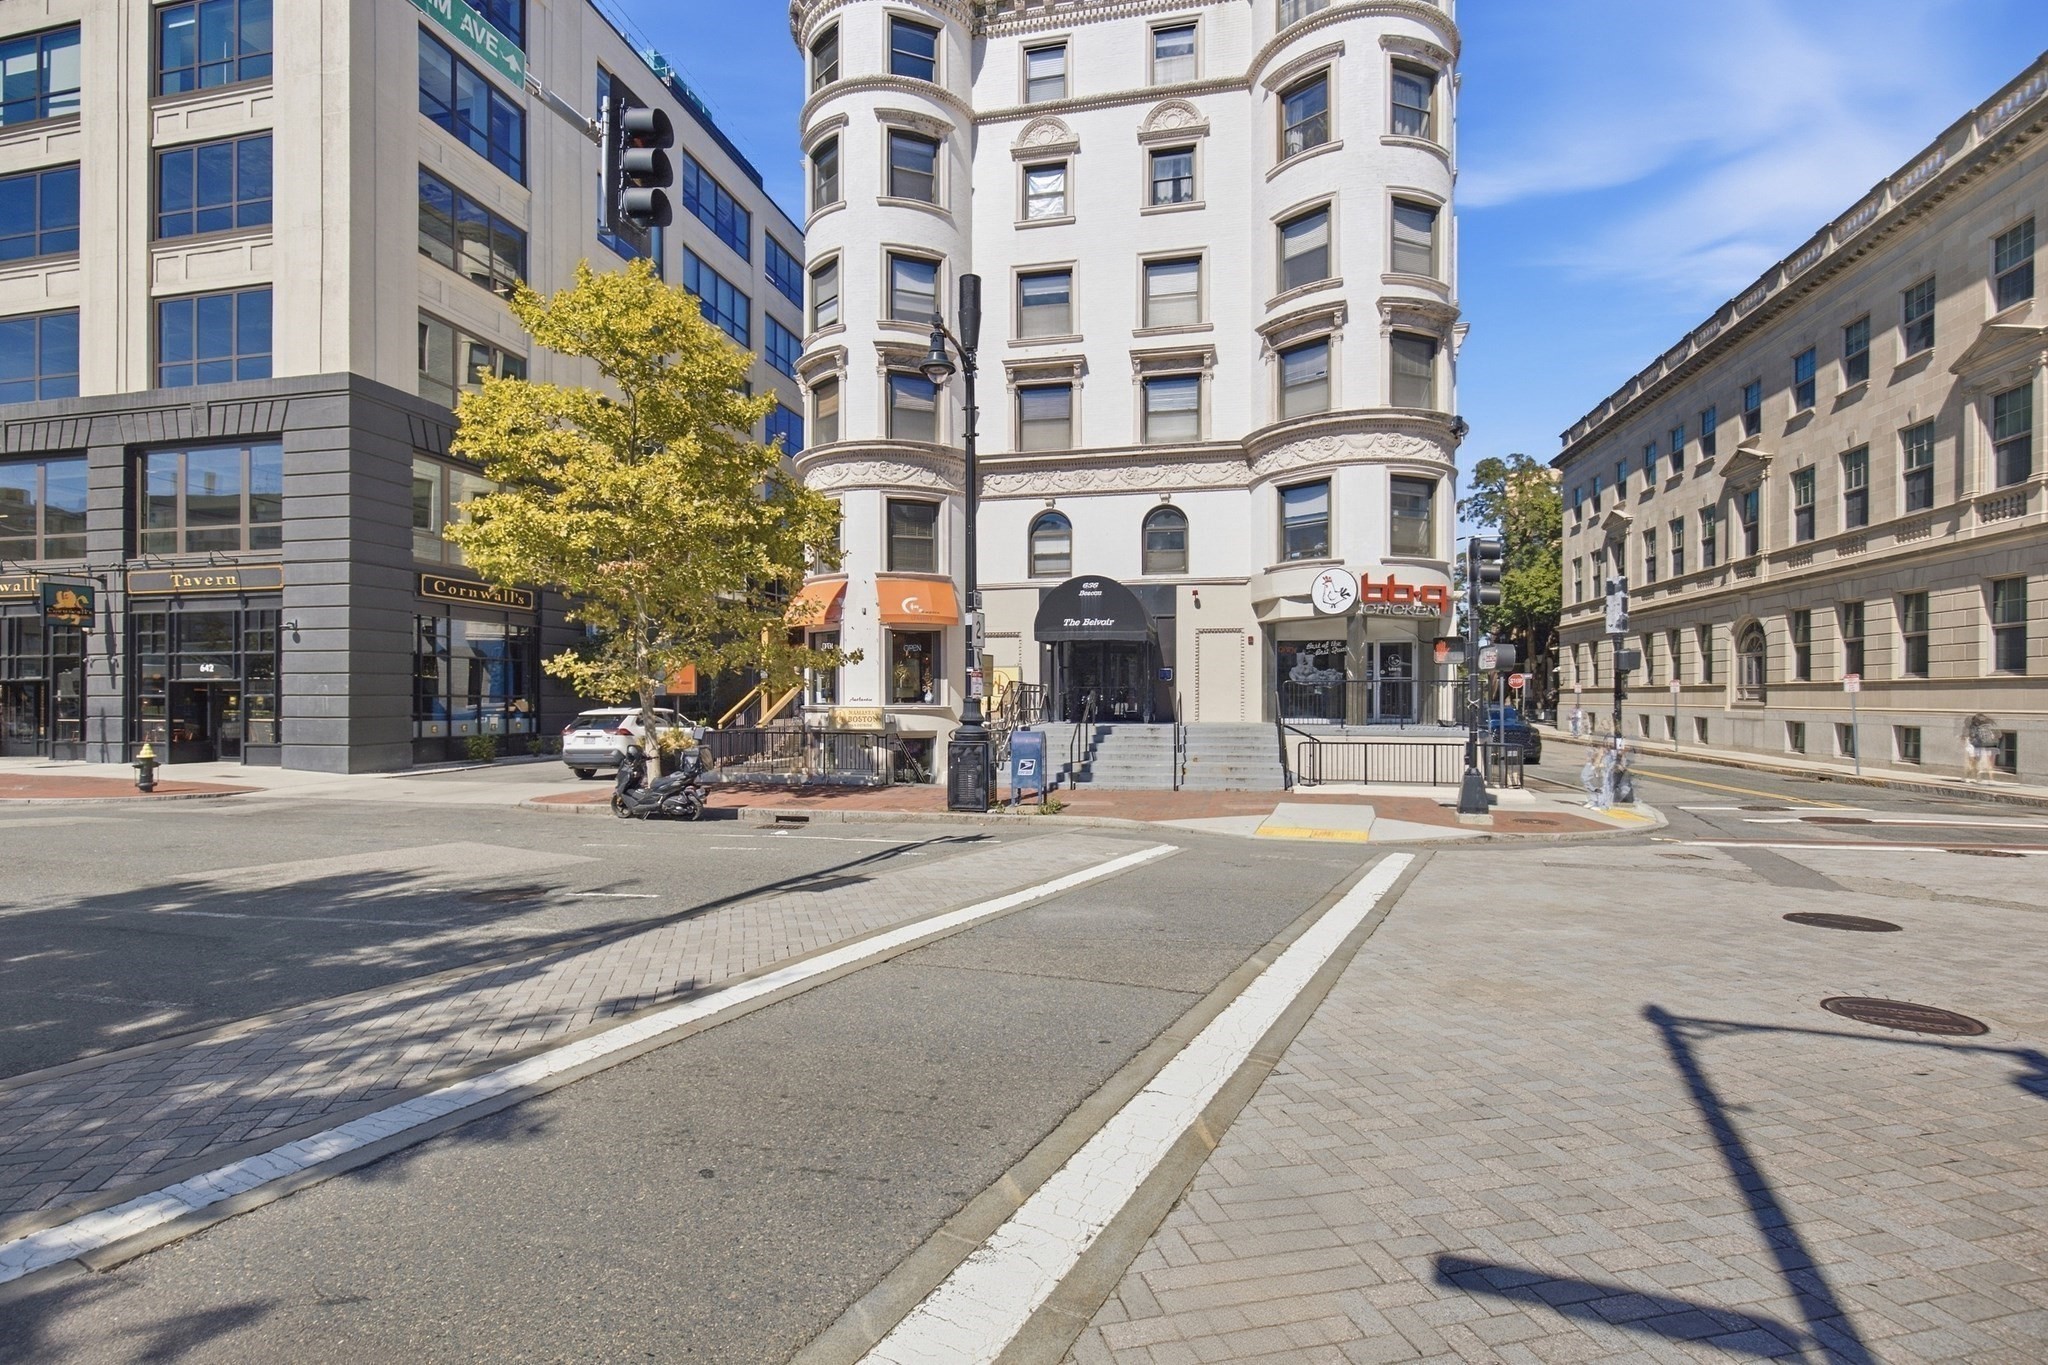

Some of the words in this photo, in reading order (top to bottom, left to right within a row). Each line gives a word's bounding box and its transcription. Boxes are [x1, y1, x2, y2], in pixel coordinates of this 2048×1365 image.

[460, 13, 499, 58] AVE
[170, 574, 237, 588] Tavern
[433, 580, 525, 605] Cornwall's
[1359, 603, 1440, 617] CHICKEN
[1063, 618, 1081, 627] The
[1082, 618, 1115, 626] Belvoir
[903, 644, 922, 652] OPEN
[200, 663, 214, 673] 642
[848, 715, 879, 723] BOSTON
